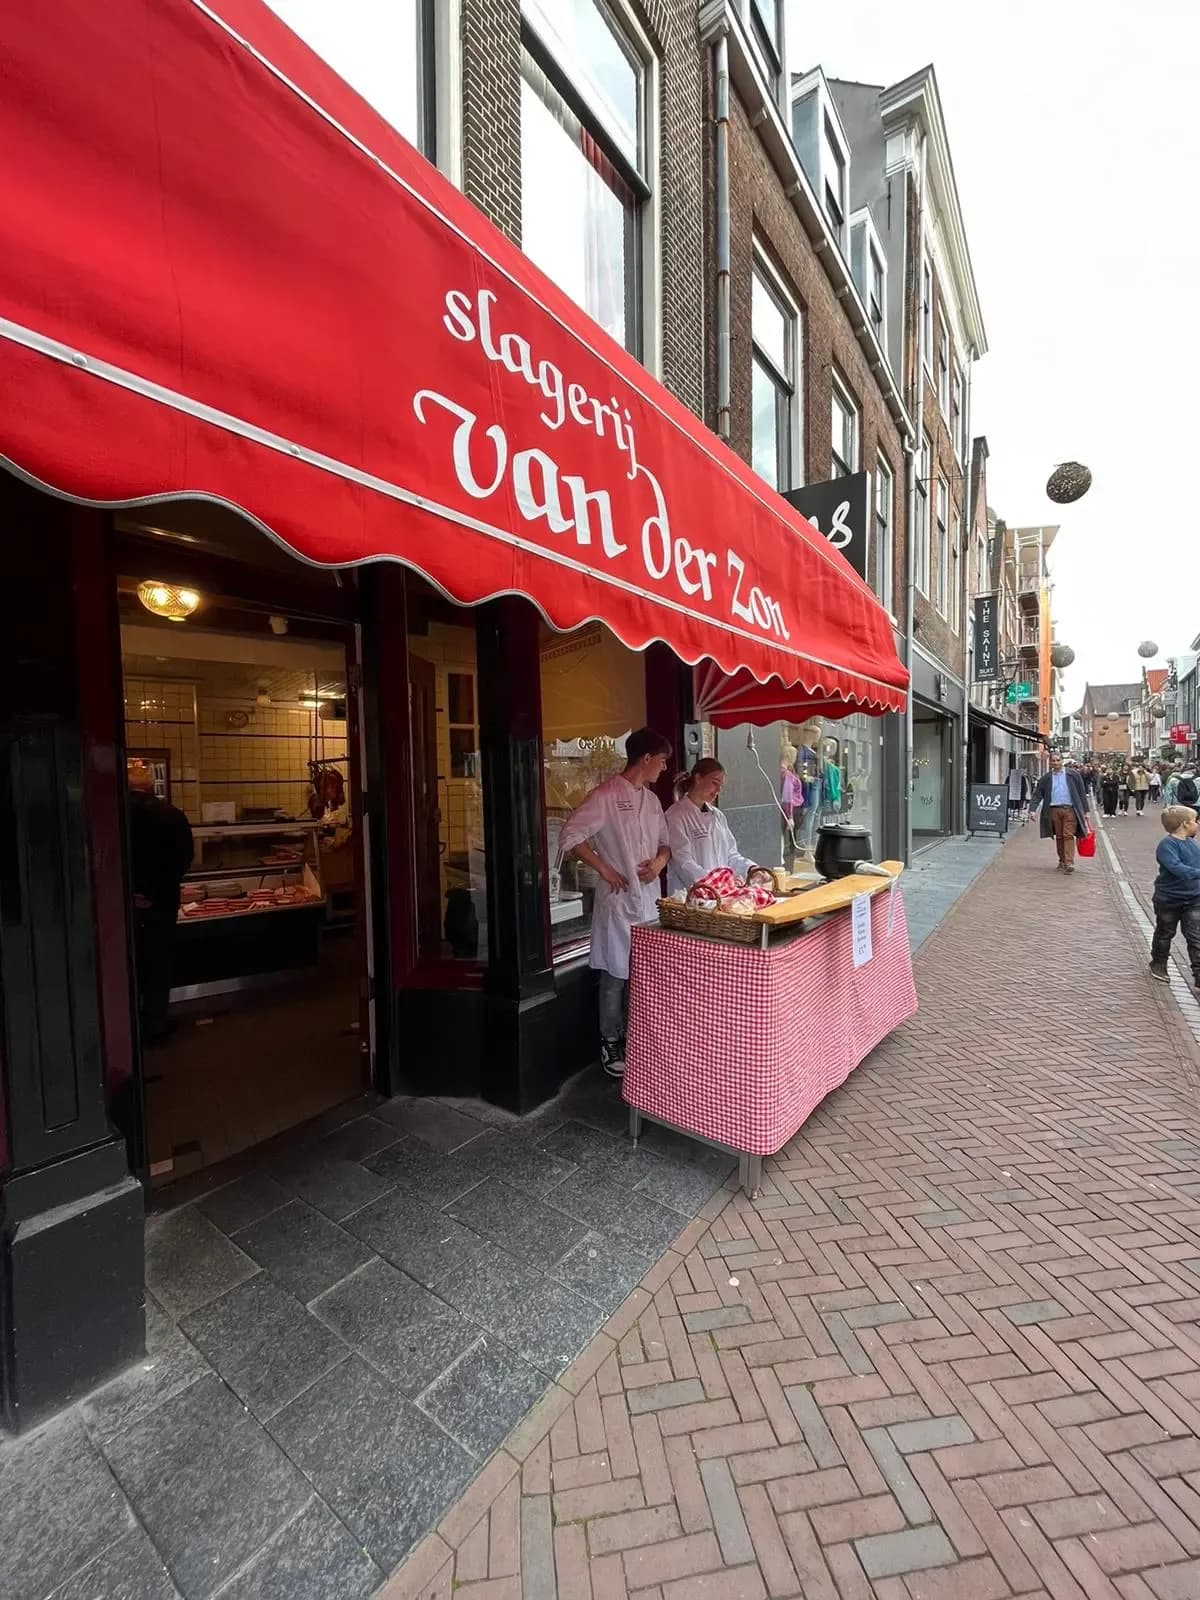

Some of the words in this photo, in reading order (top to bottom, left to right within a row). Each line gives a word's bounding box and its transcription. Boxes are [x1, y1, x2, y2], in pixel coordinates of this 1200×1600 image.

[442, 288, 638, 480] slagerij
[636, 463, 718, 601] der
[727, 549, 791, 641] Zon
[982, 600, 991, 623] THE
[982, 629, 991, 667] SAINT
